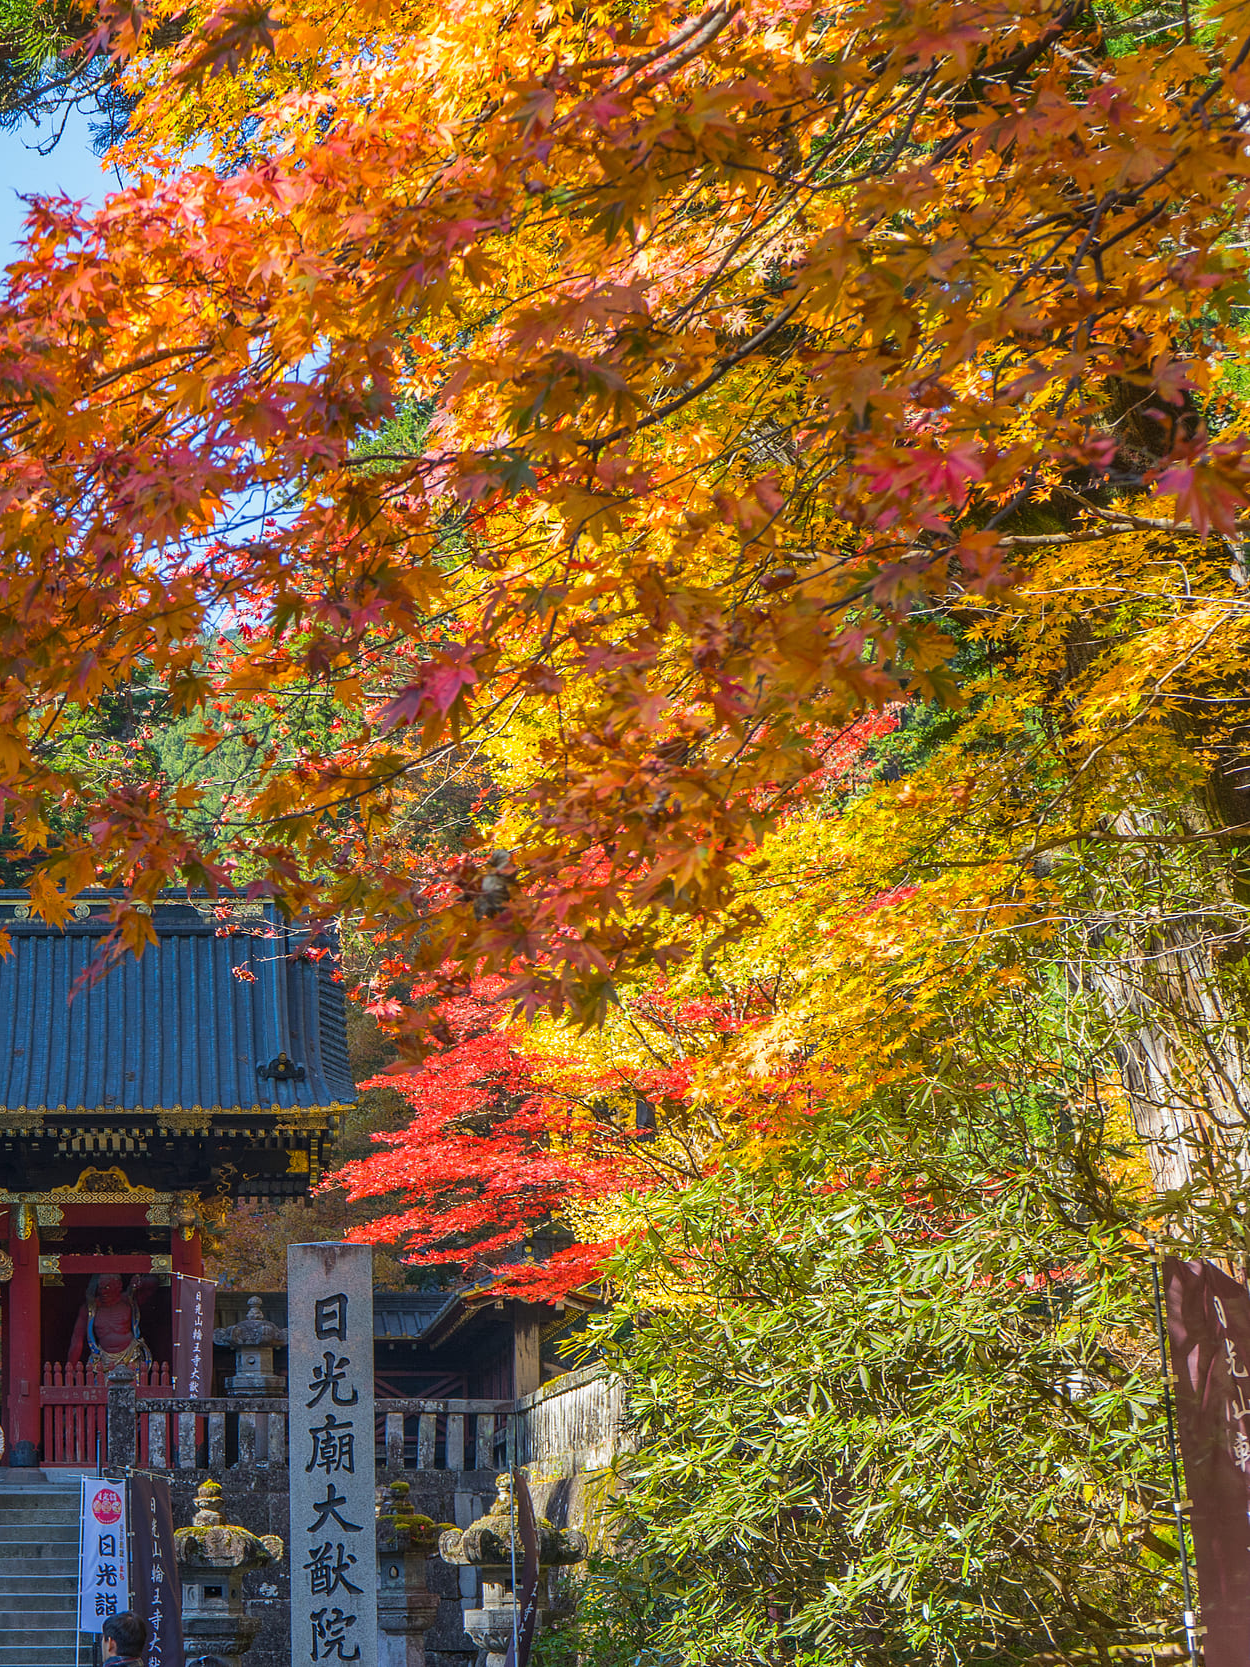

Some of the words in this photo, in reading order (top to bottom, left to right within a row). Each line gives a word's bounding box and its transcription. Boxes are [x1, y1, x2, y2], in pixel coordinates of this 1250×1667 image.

[94, 1533, 119, 1618] 日光詣
[304, 1291, 365, 1663] 日光廟大猷院
